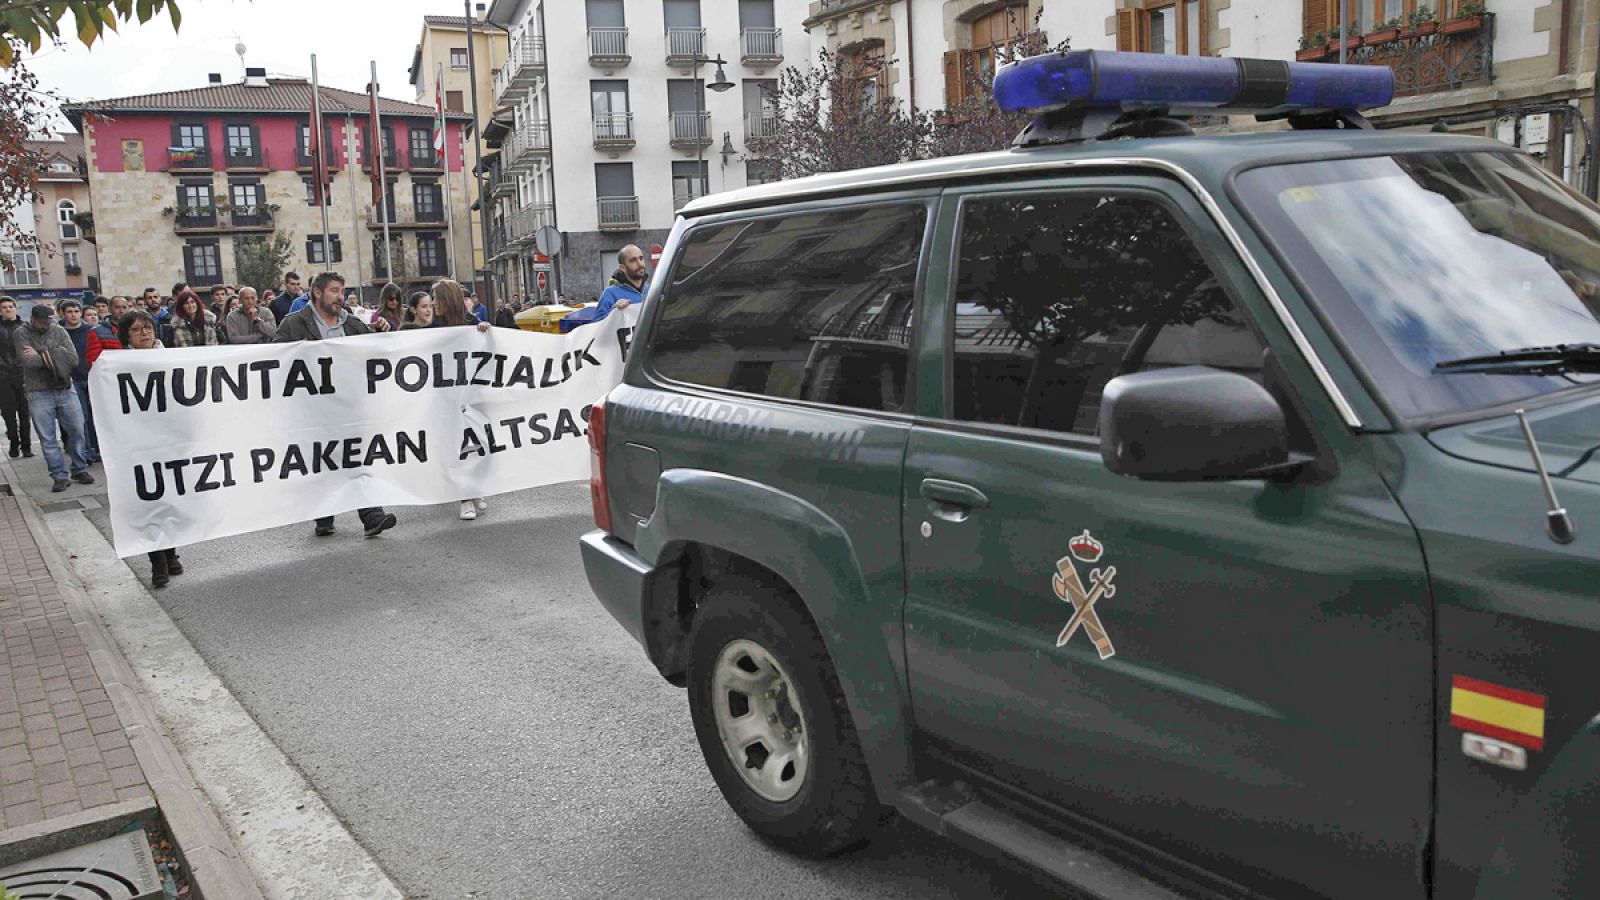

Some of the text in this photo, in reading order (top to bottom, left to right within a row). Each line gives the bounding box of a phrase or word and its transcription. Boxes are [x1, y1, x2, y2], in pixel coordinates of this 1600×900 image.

[118, 357, 336, 414] MUNTAI
[661, 396, 773, 444] GUARDIA
[133, 451, 236, 501] UTZI
[251, 430, 428, 483] PAKEAN
